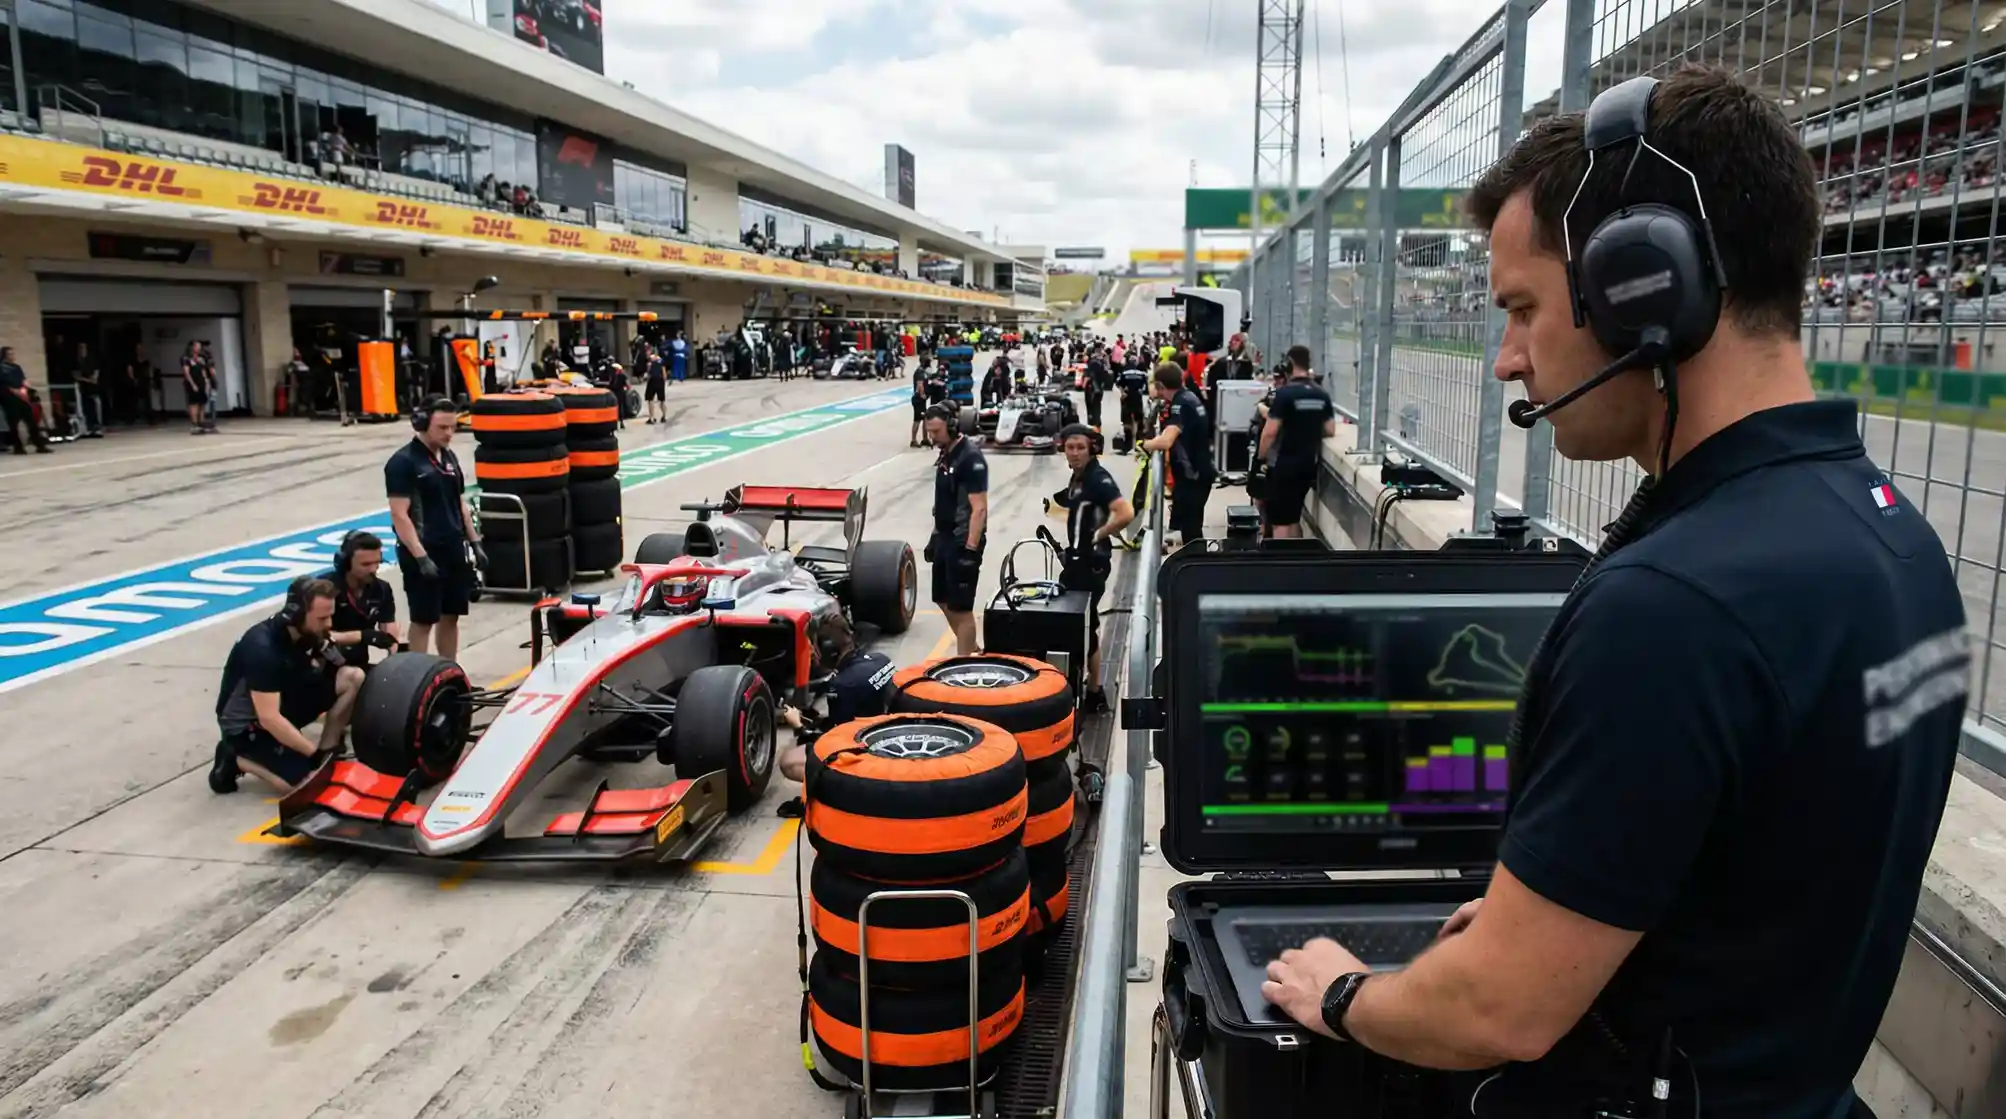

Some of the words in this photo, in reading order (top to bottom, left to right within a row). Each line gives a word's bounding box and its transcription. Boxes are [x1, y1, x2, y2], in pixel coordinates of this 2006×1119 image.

[83, 156, 184, 195] DHL
[254, 182, 325, 214] DHL
[377, 202, 432, 229] DHL
[473, 216, 516, 240] DHL
[548, 229, 583, 247] DHL
[506, 692, 564, 716] 77
